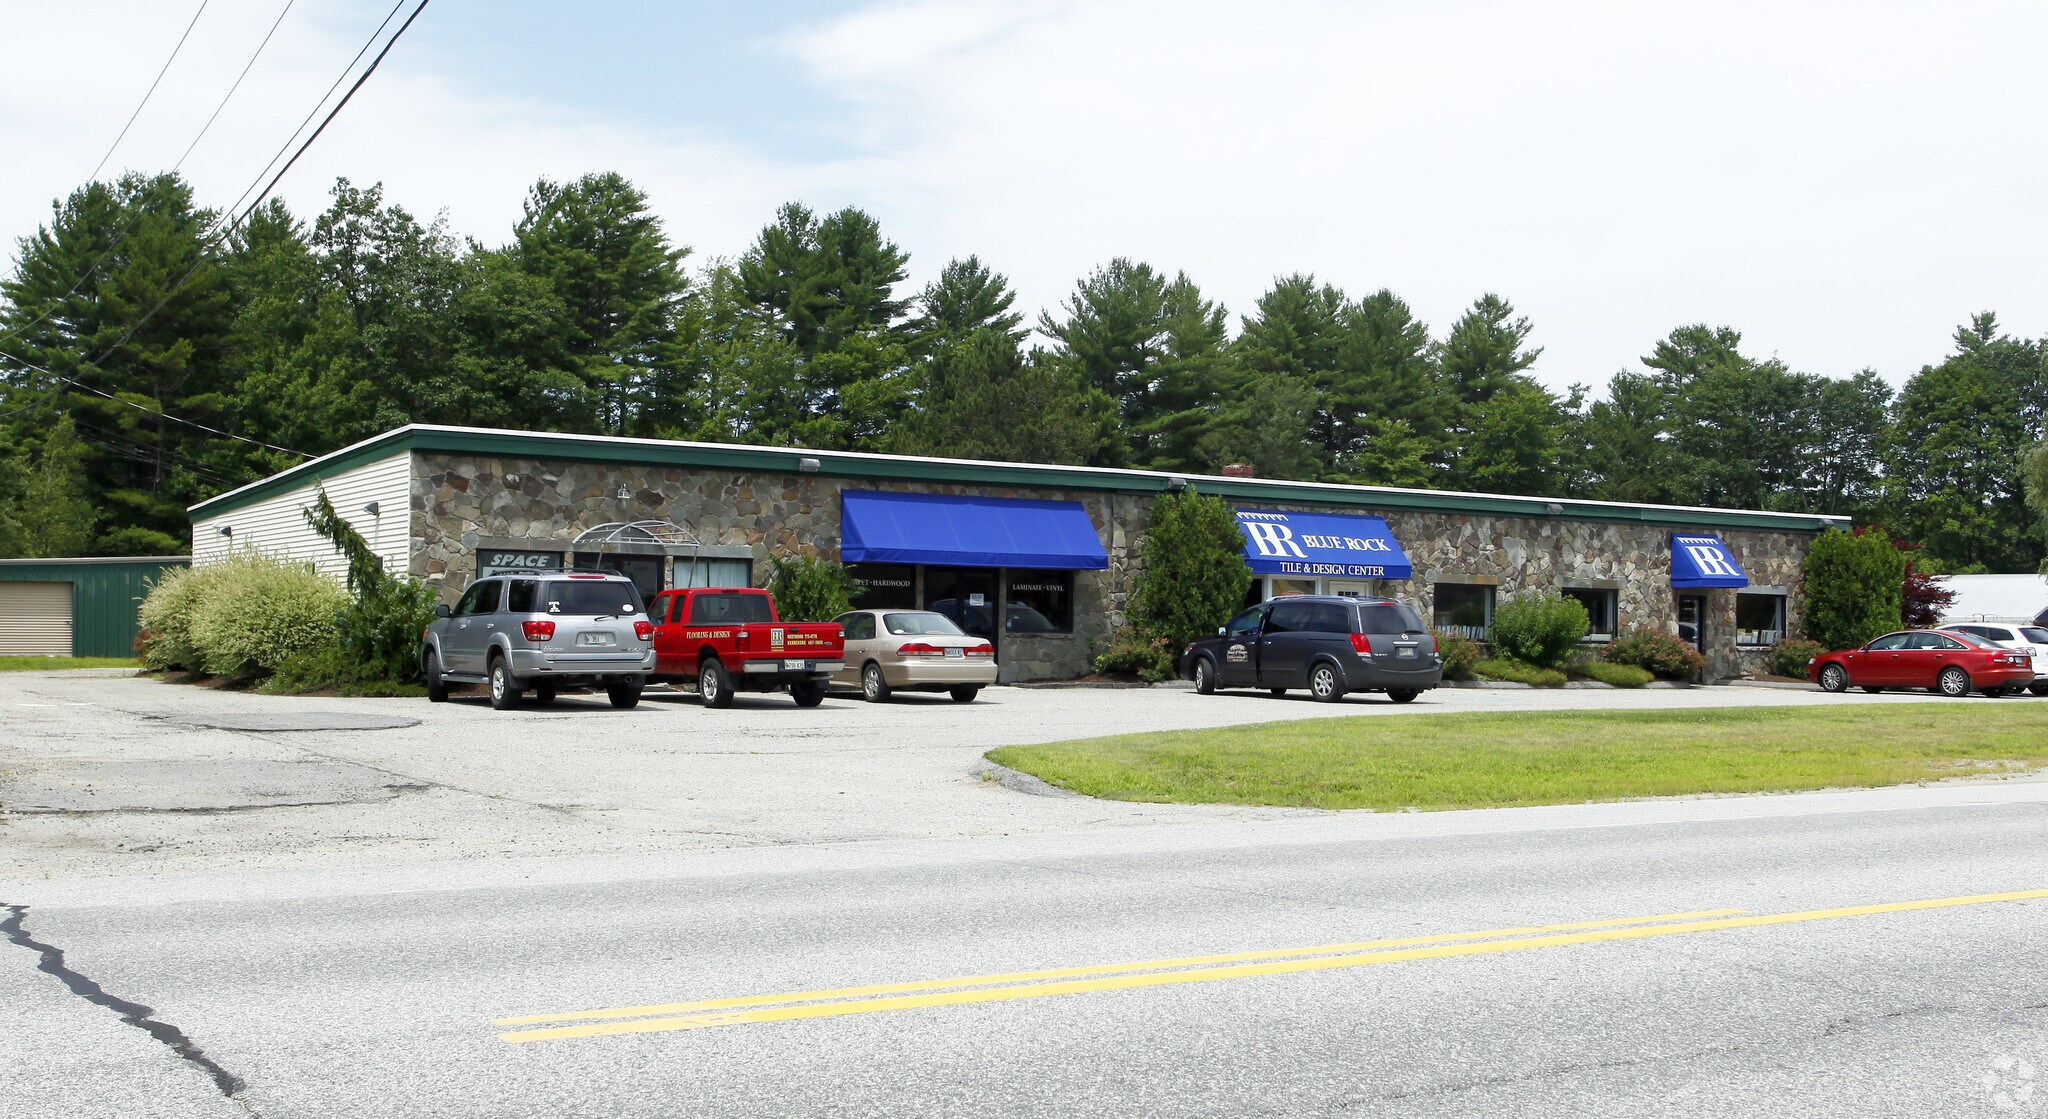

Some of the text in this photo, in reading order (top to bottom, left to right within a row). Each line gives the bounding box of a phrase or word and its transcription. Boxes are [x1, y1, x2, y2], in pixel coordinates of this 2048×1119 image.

[1301, 534, 1392, 552] BLUE ROCK
[491, 554, 550, 567] SPACE
[1280, 562, 1385, 576] TILE & DESIGN CENTER
[1045, 584, 1064, 592] VINYL
[686, 631, 709, 639] FLOORING
